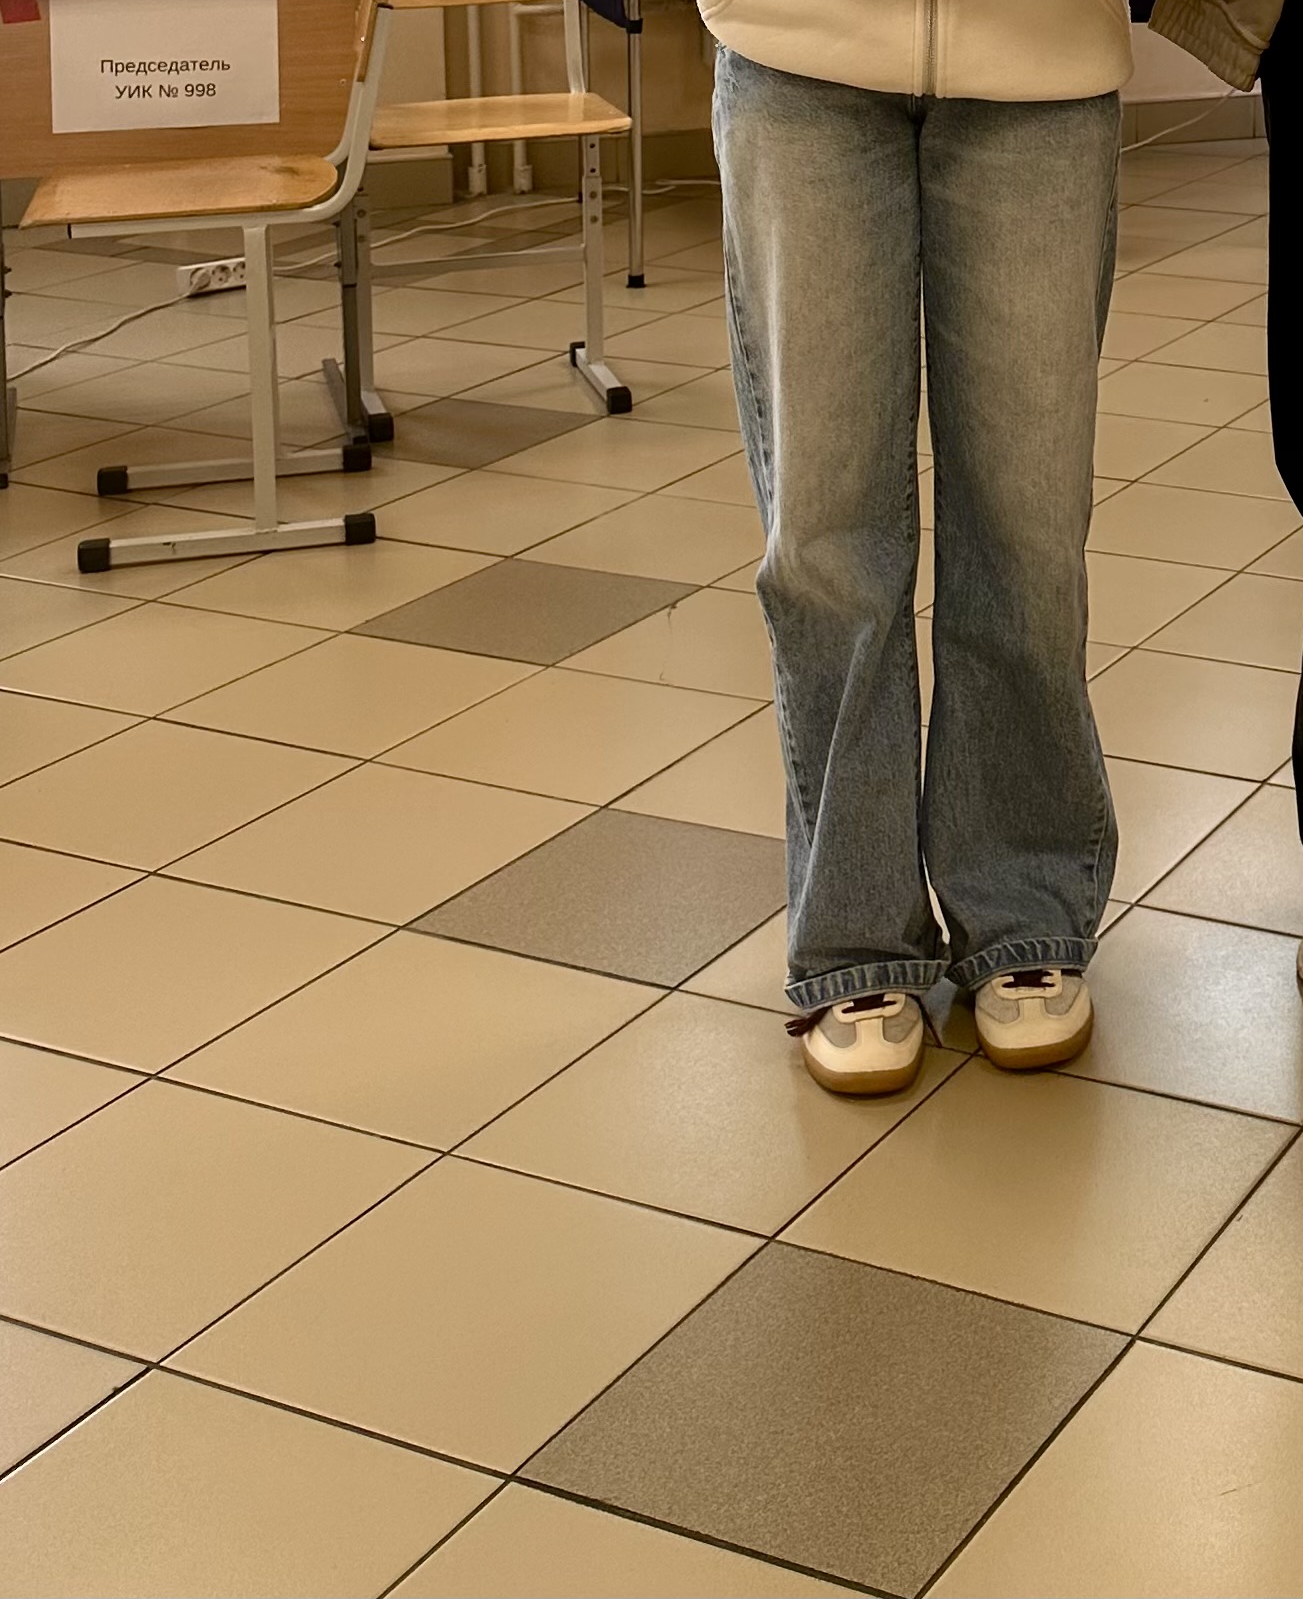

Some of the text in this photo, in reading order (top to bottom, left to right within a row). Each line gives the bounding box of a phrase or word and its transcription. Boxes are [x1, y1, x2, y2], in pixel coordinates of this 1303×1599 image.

[100, 59, 231, 77] Председатель
[115, 83, 217, 99] УИК № 998
